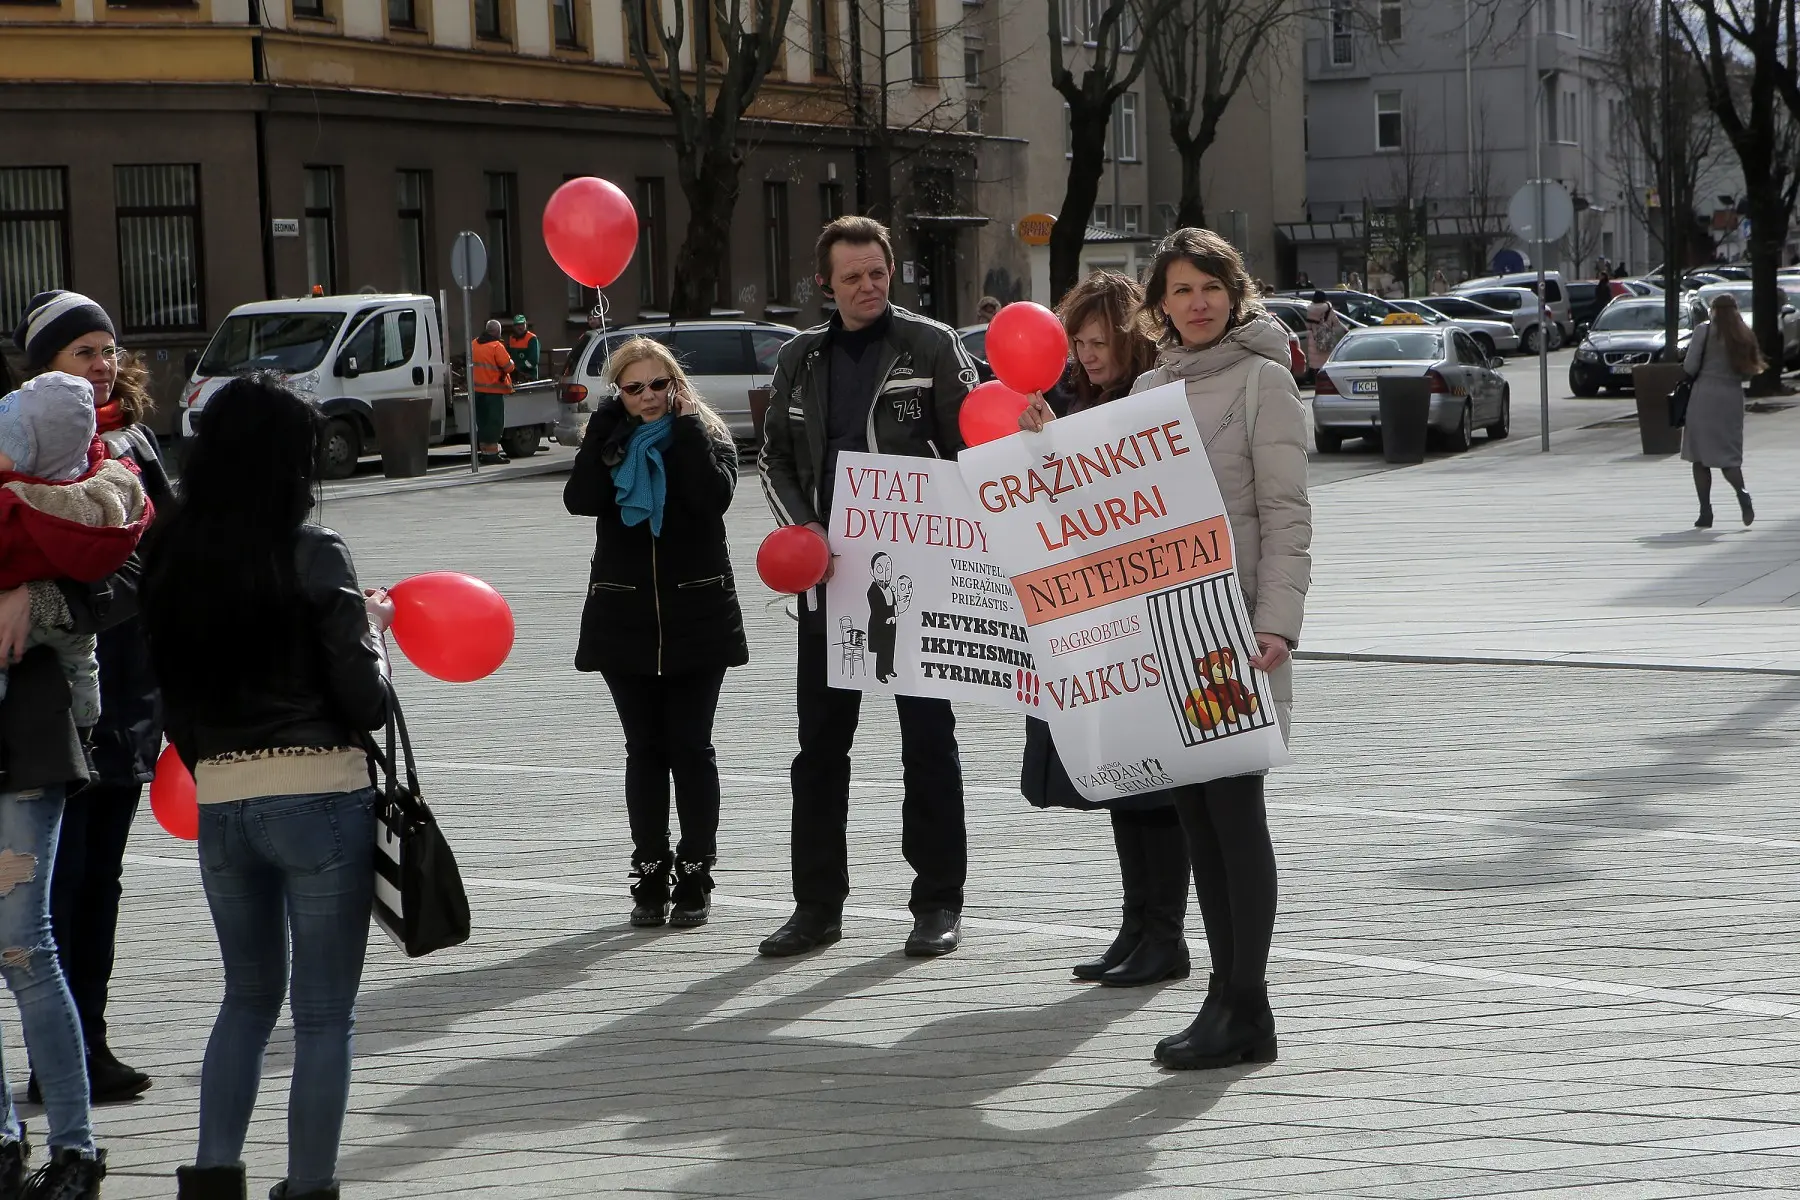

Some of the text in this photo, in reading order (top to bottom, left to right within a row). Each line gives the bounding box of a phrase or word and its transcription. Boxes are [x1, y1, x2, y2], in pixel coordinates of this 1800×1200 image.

[1358, 383, 1377, 391] KCH
[893, 398, 921, 422] 74
[979, 420, 1190, 513] GRĄŽINKITE
[846, 467, 929, 503] VTAT
[1036, 485, 1168, 552] LAURAI
[950, 558, 1006, 579] VIENINTEL
[1027, 530, 1221, 613] NETEISĖTAI
[951, 592, 1008, 612] PRIEŽASTIS
[1049, 615, 1141, 655] PAGROBTUS
[921, 661, 1013, 690] TYRIMAS
[1045, 652, 1161, 711] VAIKUS
